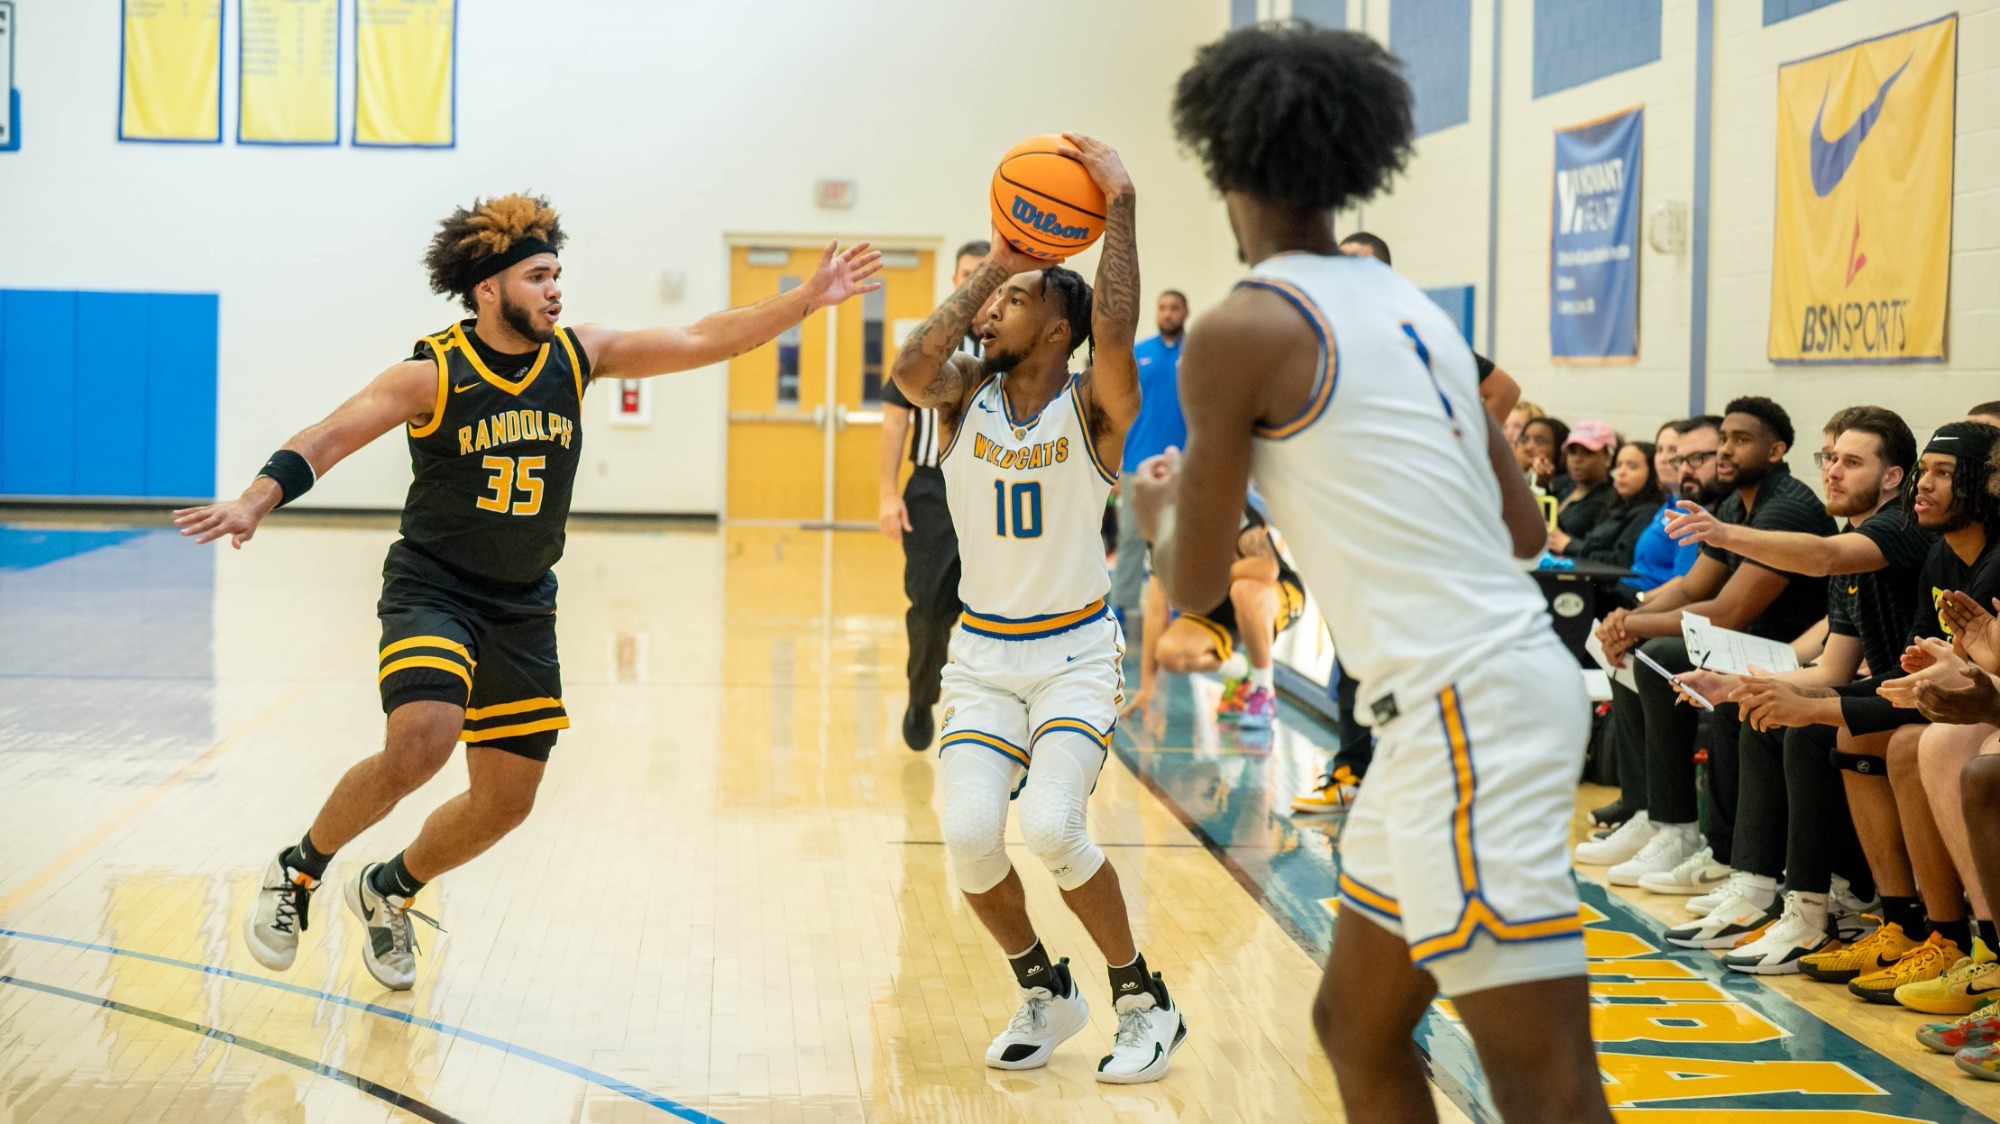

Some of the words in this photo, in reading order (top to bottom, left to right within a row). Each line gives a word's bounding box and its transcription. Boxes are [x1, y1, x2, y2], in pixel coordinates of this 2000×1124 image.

[1012, 195, 1090, 239] Wilson
[458, 409, 573, 456] RANDOLPH
[973, 432, 1069, 471] WILDCATS
[476, 455, 546, 516] 35
[993, 477, 1044, 541] 10
